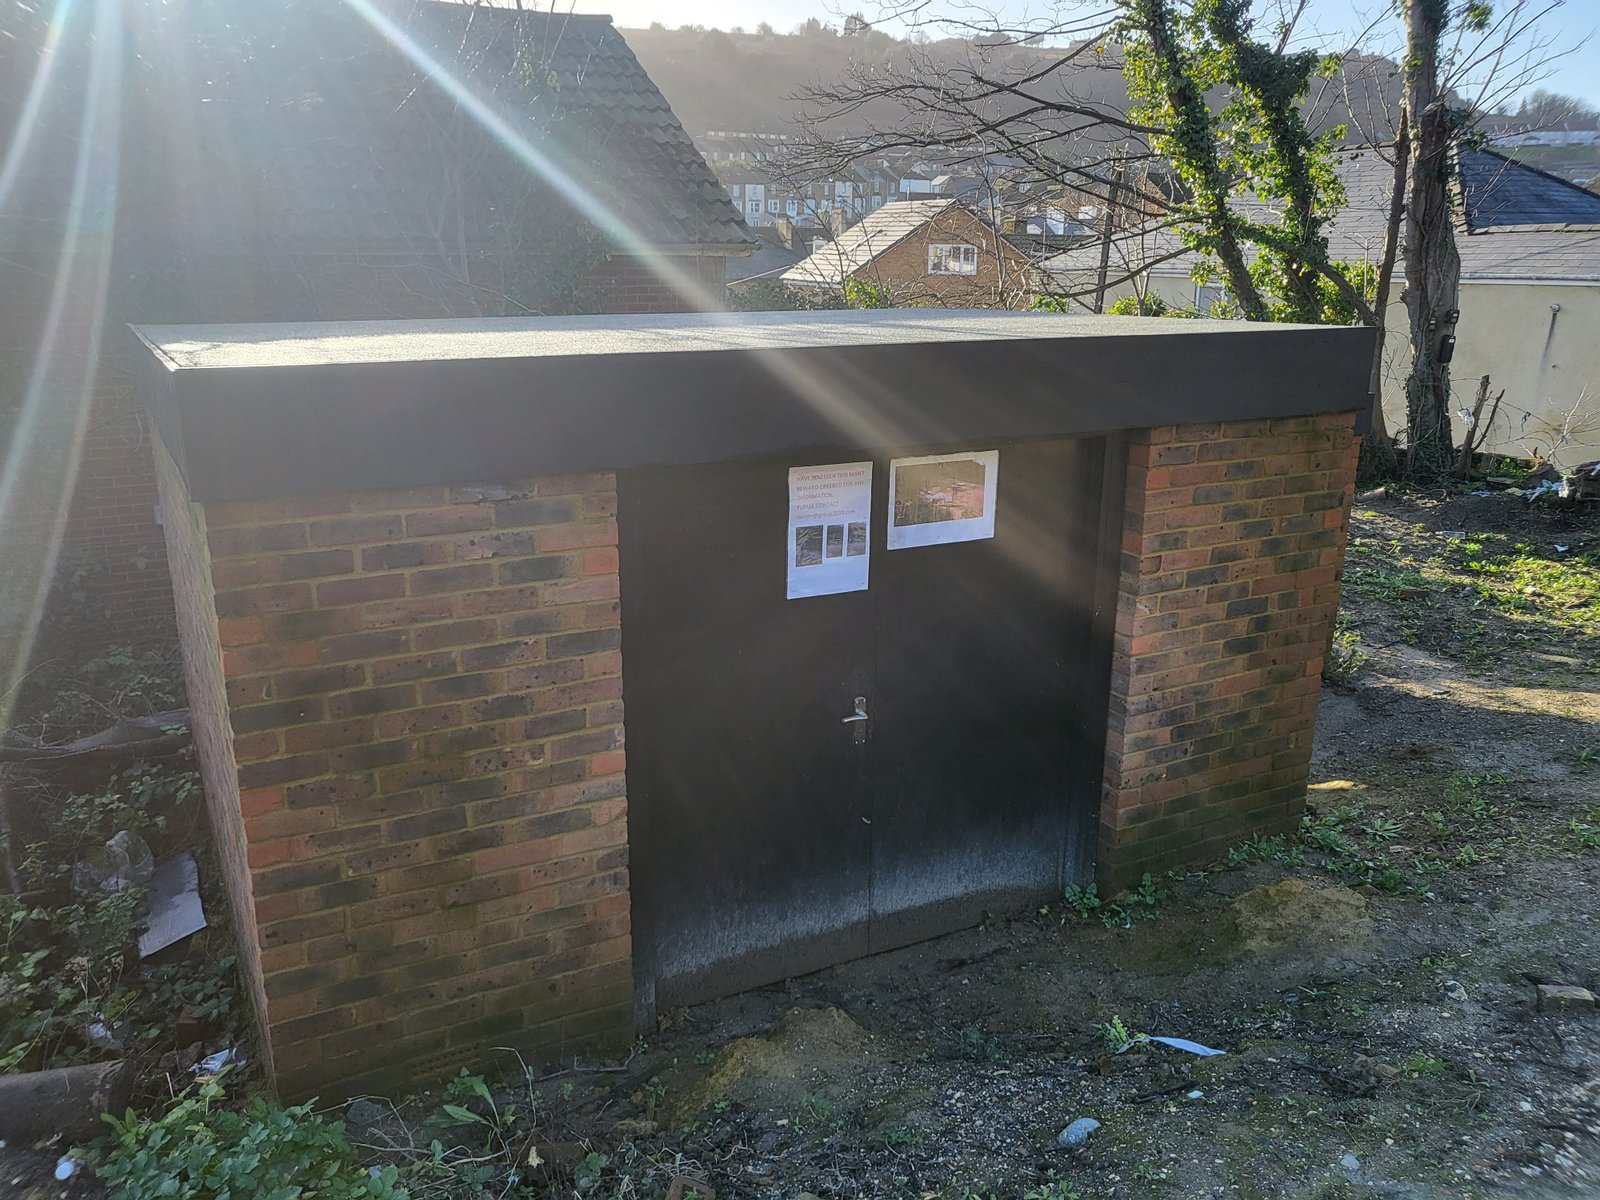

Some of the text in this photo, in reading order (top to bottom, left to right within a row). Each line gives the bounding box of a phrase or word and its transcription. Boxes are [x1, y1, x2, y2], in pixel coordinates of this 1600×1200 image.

[824, 472, 837, 480] SEEN
[796, 501, 839, 511] PLEASE CONTACT
